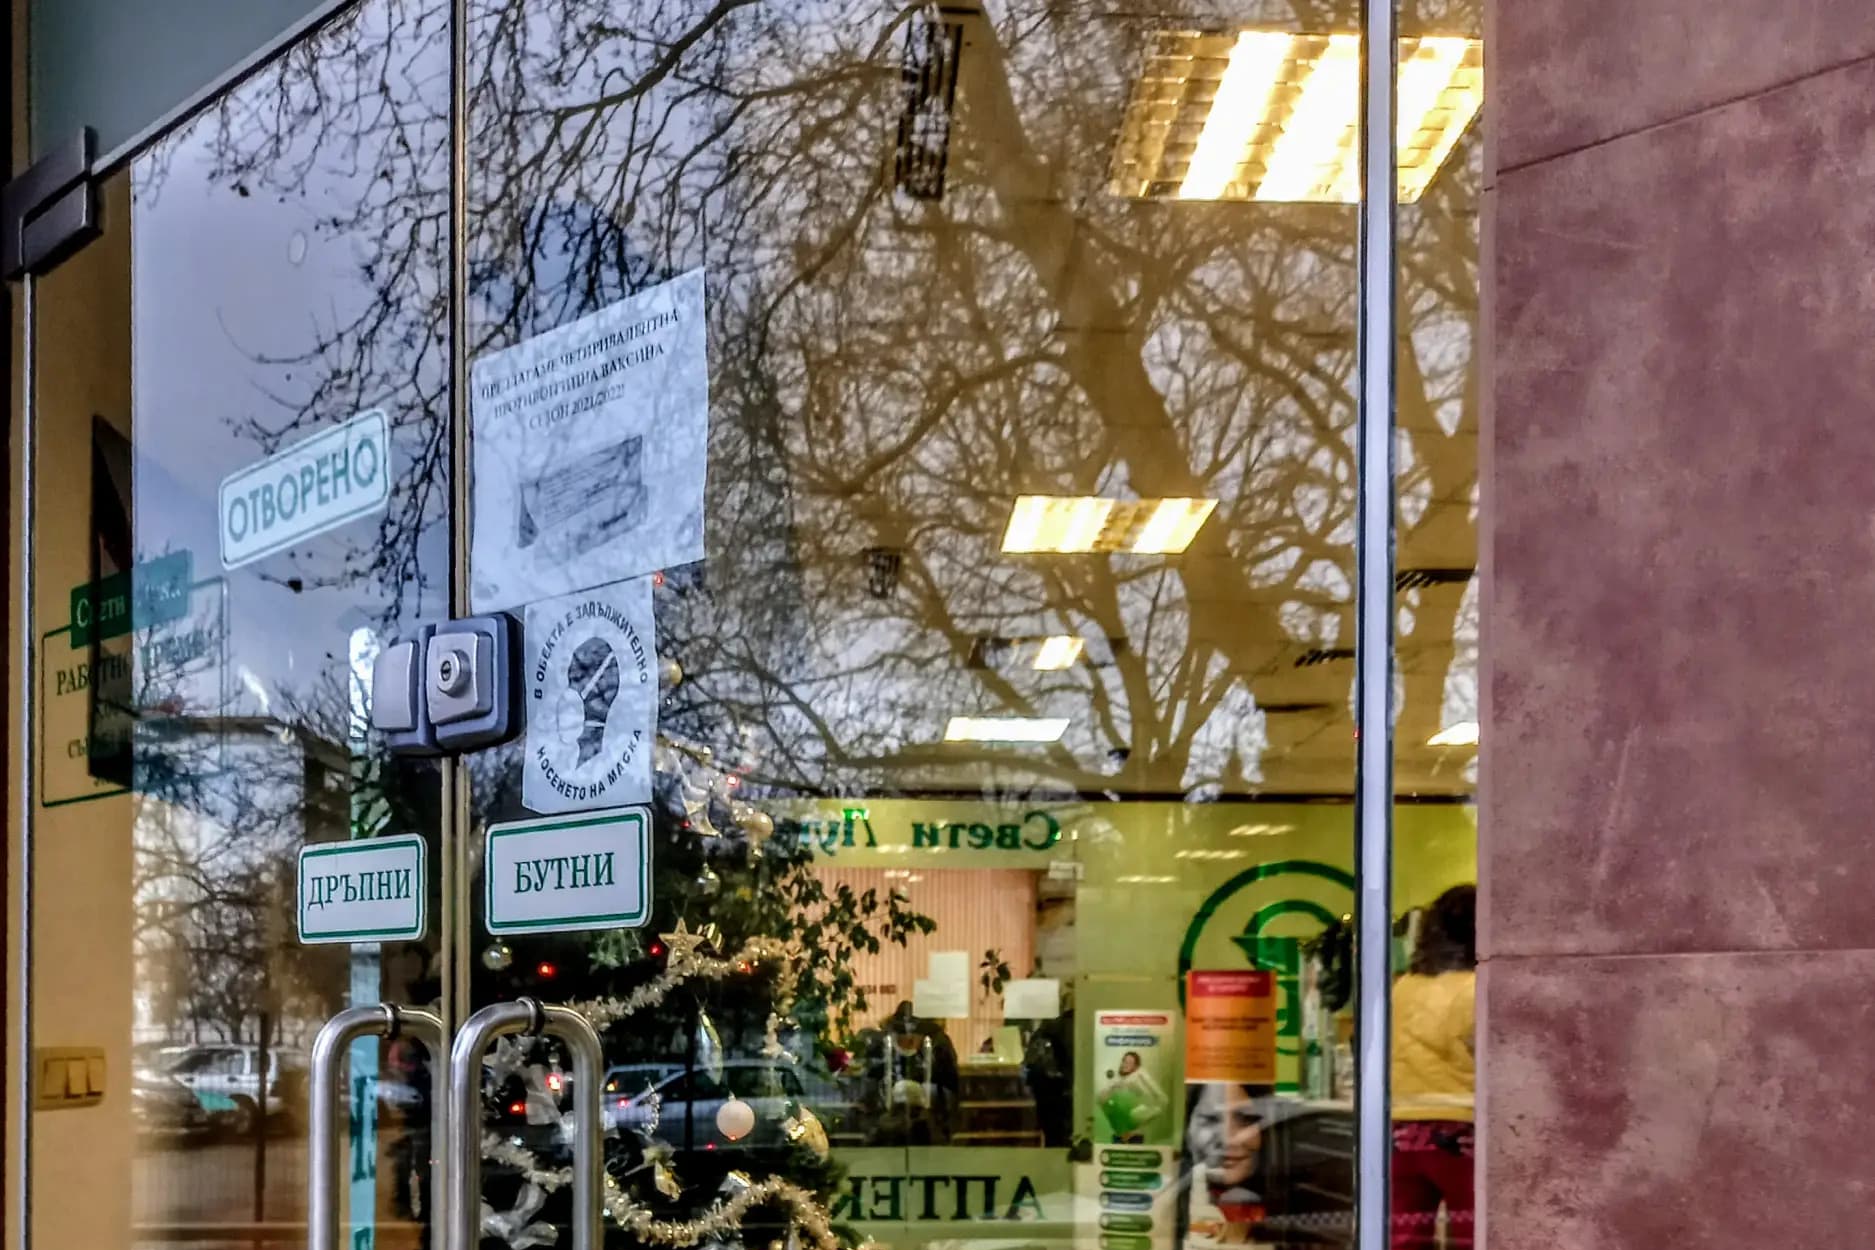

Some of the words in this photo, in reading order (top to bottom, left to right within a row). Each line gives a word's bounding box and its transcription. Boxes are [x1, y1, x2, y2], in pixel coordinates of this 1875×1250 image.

[601, 343, 664, 379] ВАКСИНА
[227, 437, 379, 543] ОТВОРЕНО
[76, 595, 127, 628] Сети
[536, 622, 565, 683] ОБЕКТА
[566, 613, 574, 626] Е
[575, 600, 648, 684] ЗАДЪЛЖИТЕЛНО
[537, 746, 586, 800] НОСЕНЕТО
[590, 783, 606, 799] НА
[608, 728, 642, 785] МАСКА
[307, 868, 411, 910] ДРЪПНИ
[513, 851, 615, 893] БУТНИ
